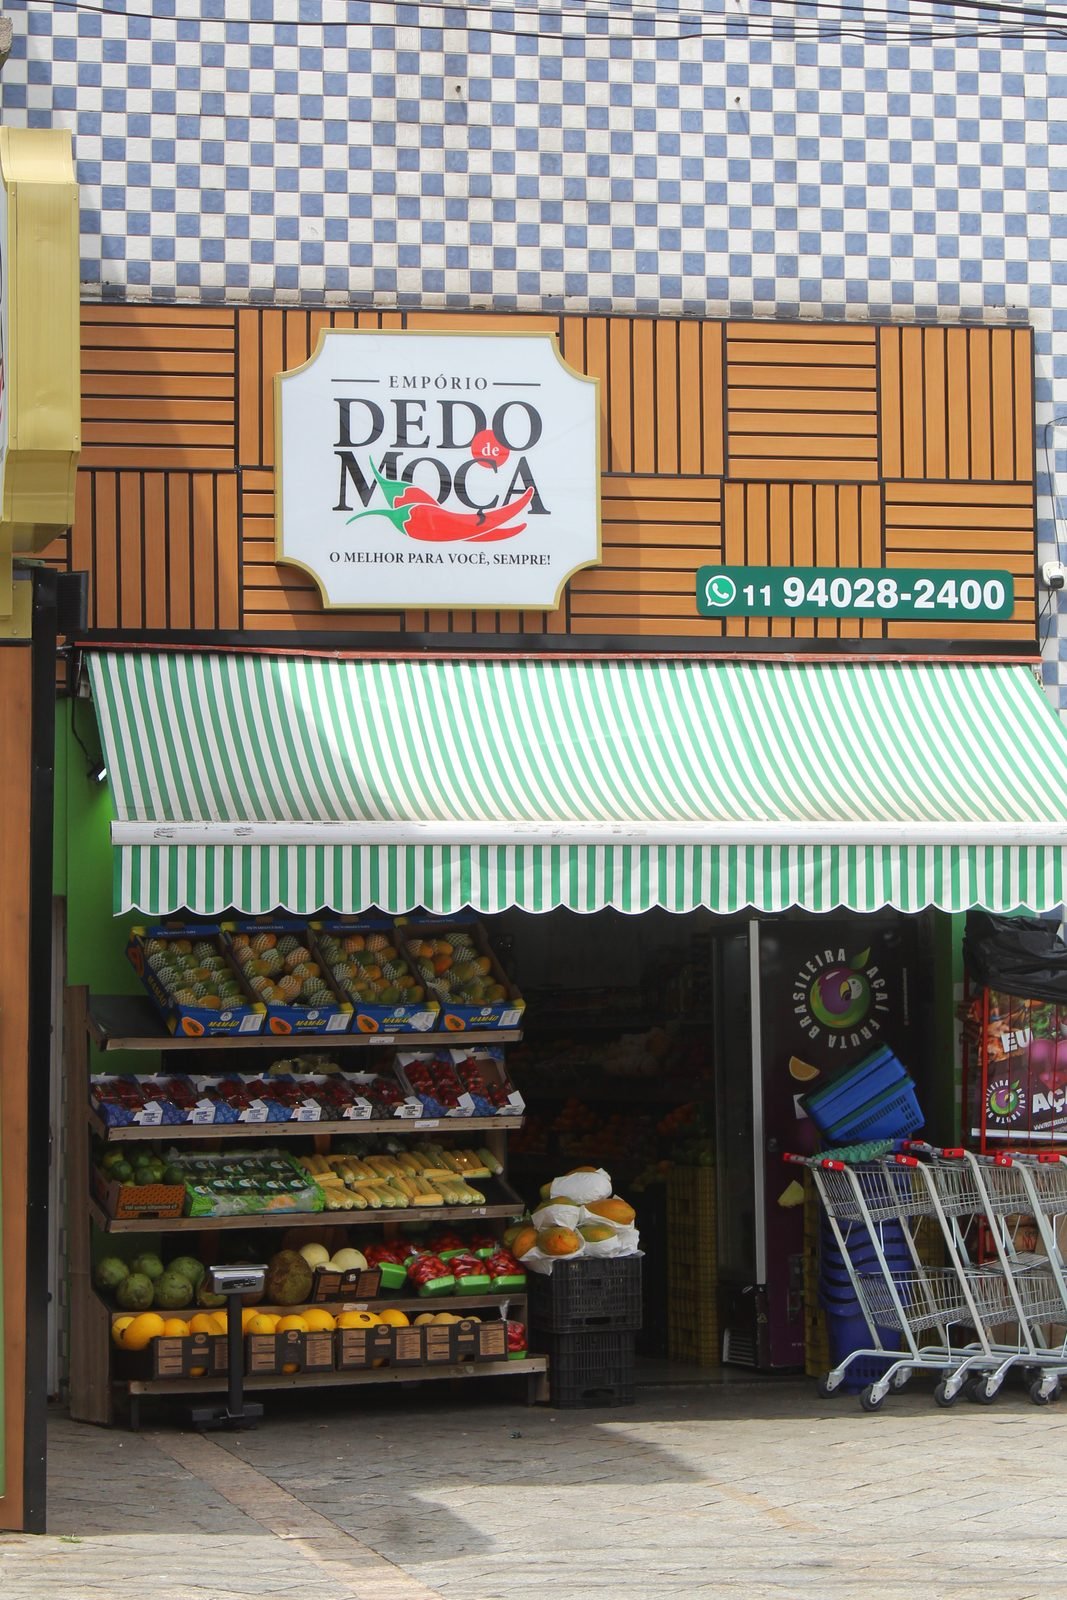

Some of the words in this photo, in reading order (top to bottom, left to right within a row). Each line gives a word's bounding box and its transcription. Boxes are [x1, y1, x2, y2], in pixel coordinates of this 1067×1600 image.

[388, 373, 488, 390] EMPÓRIO
[333, 398, 543, 452] DEDO
[481, 441, 500, 457] de
[332, 450, 551, 526] MOÇA
[329, 551, 341, 563] O
[344, 552, 404, 564] MELHOR
[408, 552, 444, 564] PARA
[448, 551, 490, 566] VOCÊ,
[493, 553, 551, 566] SEMPRE!
[742, 584, 771, 606] 11
[783, 576, 1005, 610] 94028-2400
[792, 948, 846, 1039] BRASILEIRA
[828, 1018, 880, 1049] FRUTA
[1000, 1027, 1034, 1053] EU
[1032, 1086, 1067, 1114] AÇ
